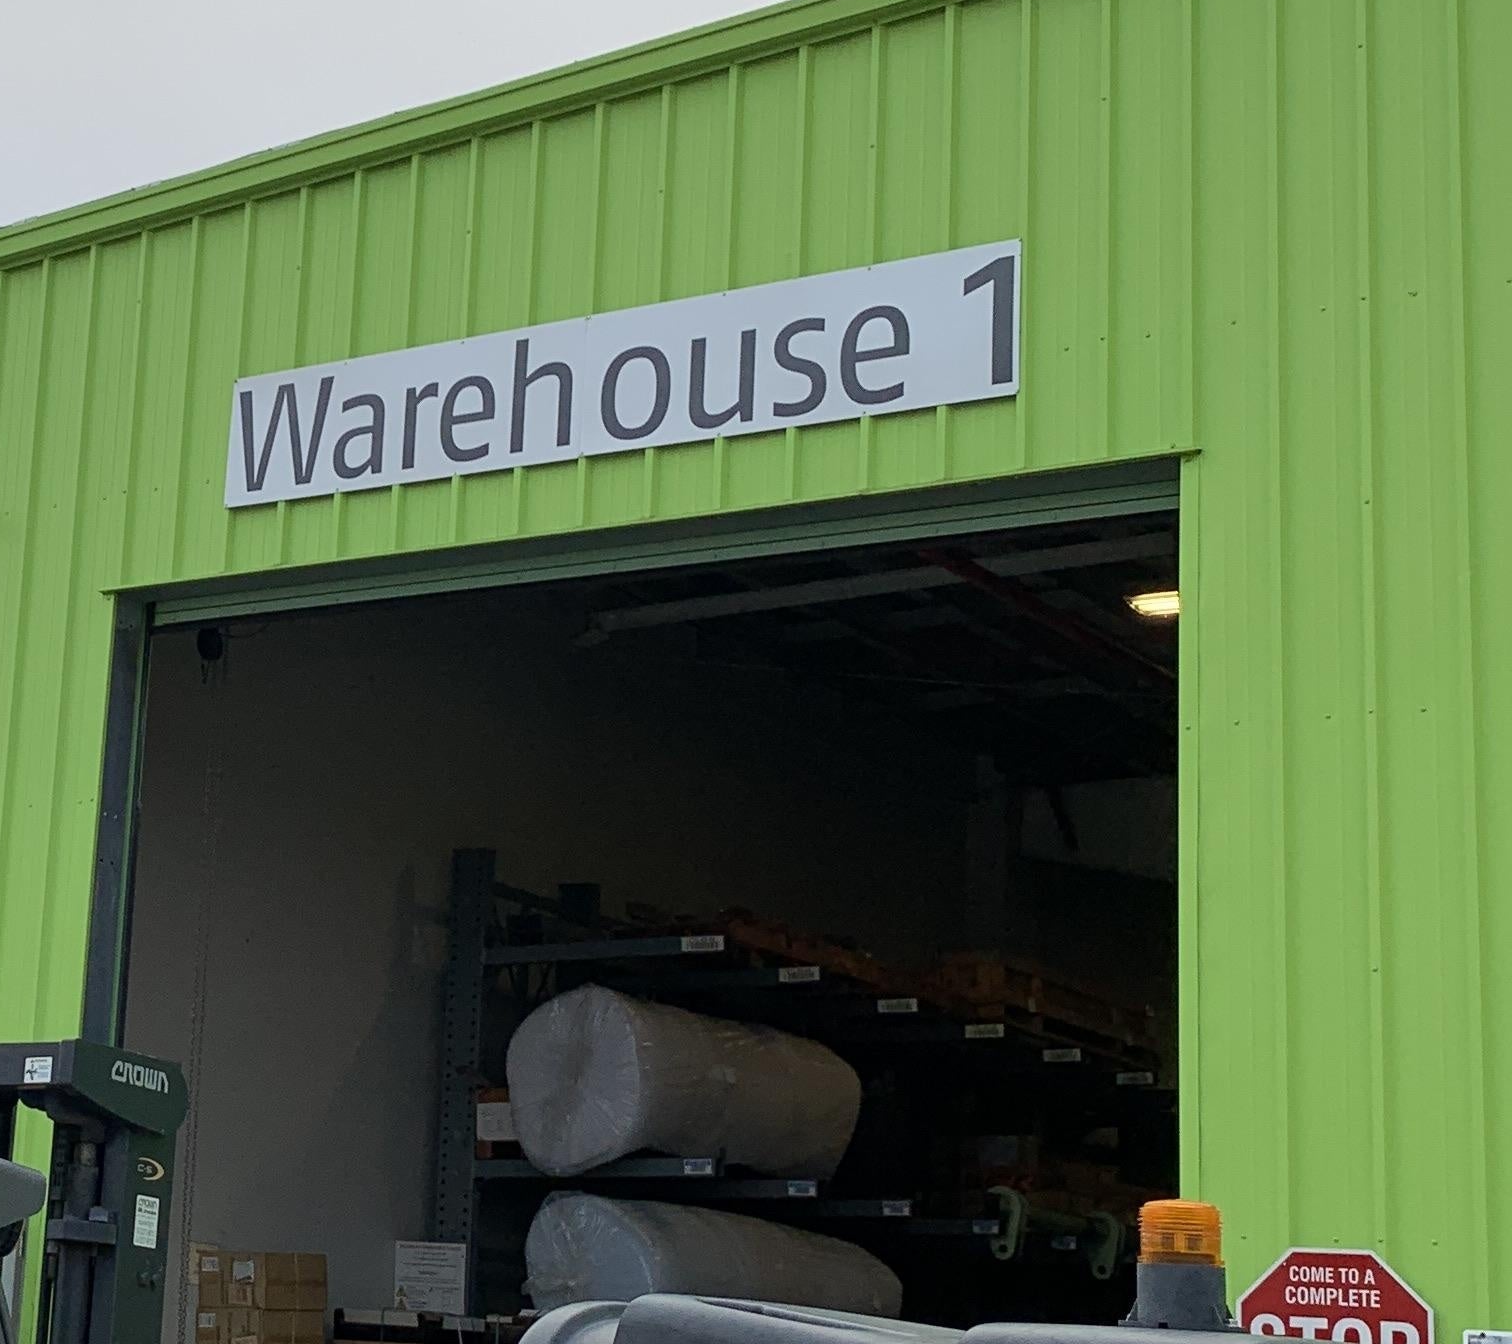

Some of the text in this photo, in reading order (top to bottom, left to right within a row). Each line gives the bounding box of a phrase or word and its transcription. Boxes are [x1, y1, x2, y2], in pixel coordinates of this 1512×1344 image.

[240, 255, 1015, 493] Warehouse 1
[111, 1060, 169, 1094] CROWN
[1289, 1265, 1376, 1286] COME TO A
[1284, 1285, 1381, 1308] COMPLETE
